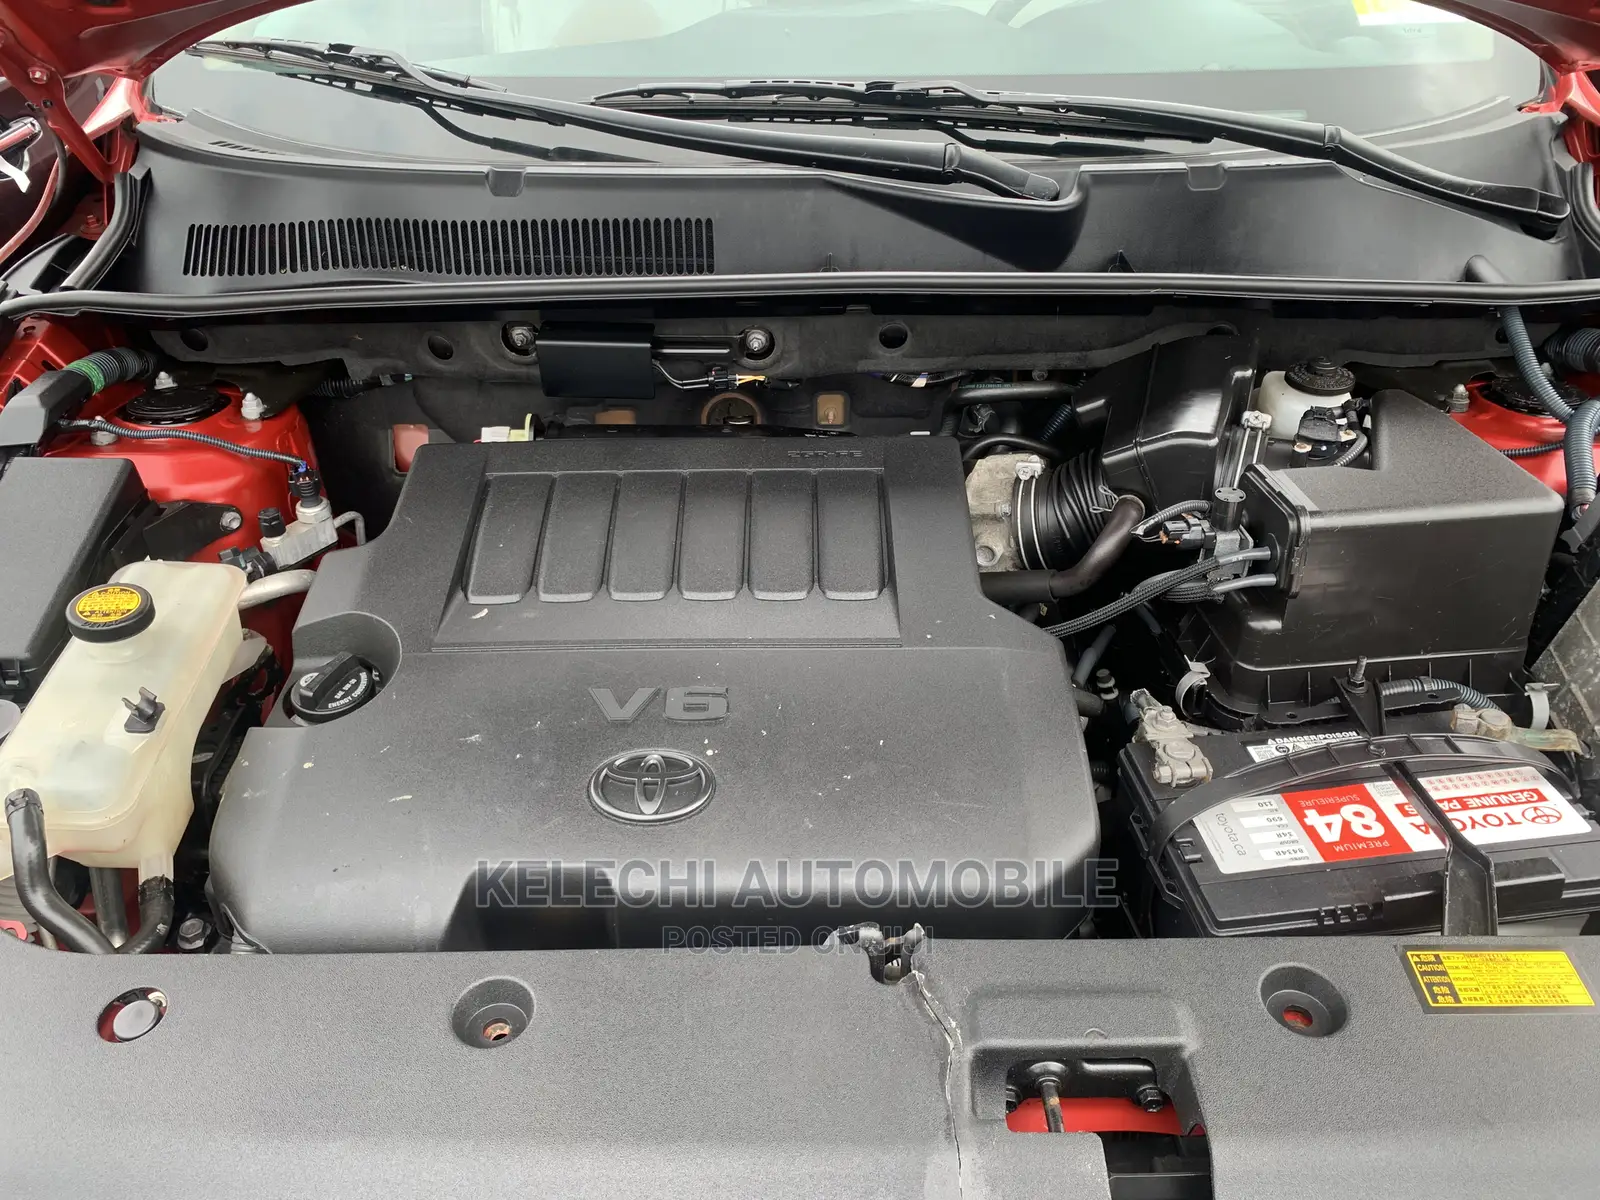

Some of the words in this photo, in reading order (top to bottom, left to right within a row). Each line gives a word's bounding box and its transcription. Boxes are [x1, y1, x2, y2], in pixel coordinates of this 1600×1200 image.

[328, 696, 352, 708] ENERGY
[588, 685, 729, 723] V6
[1404, 799, 1459, 815] PAS
[1463, 791, 1538, 808] GENUINE
[1304, 803, 1385, 843] 84
[1410, 811, 1523, 836] TOYOA
[1215, 811, 1247, 857] toyota.ca
[1333, 839, 1390, 853] PREMIUM
[1417, 964, 1446, 972] CAUTION
[1423, 975, 1451, 983] ATTENTION
